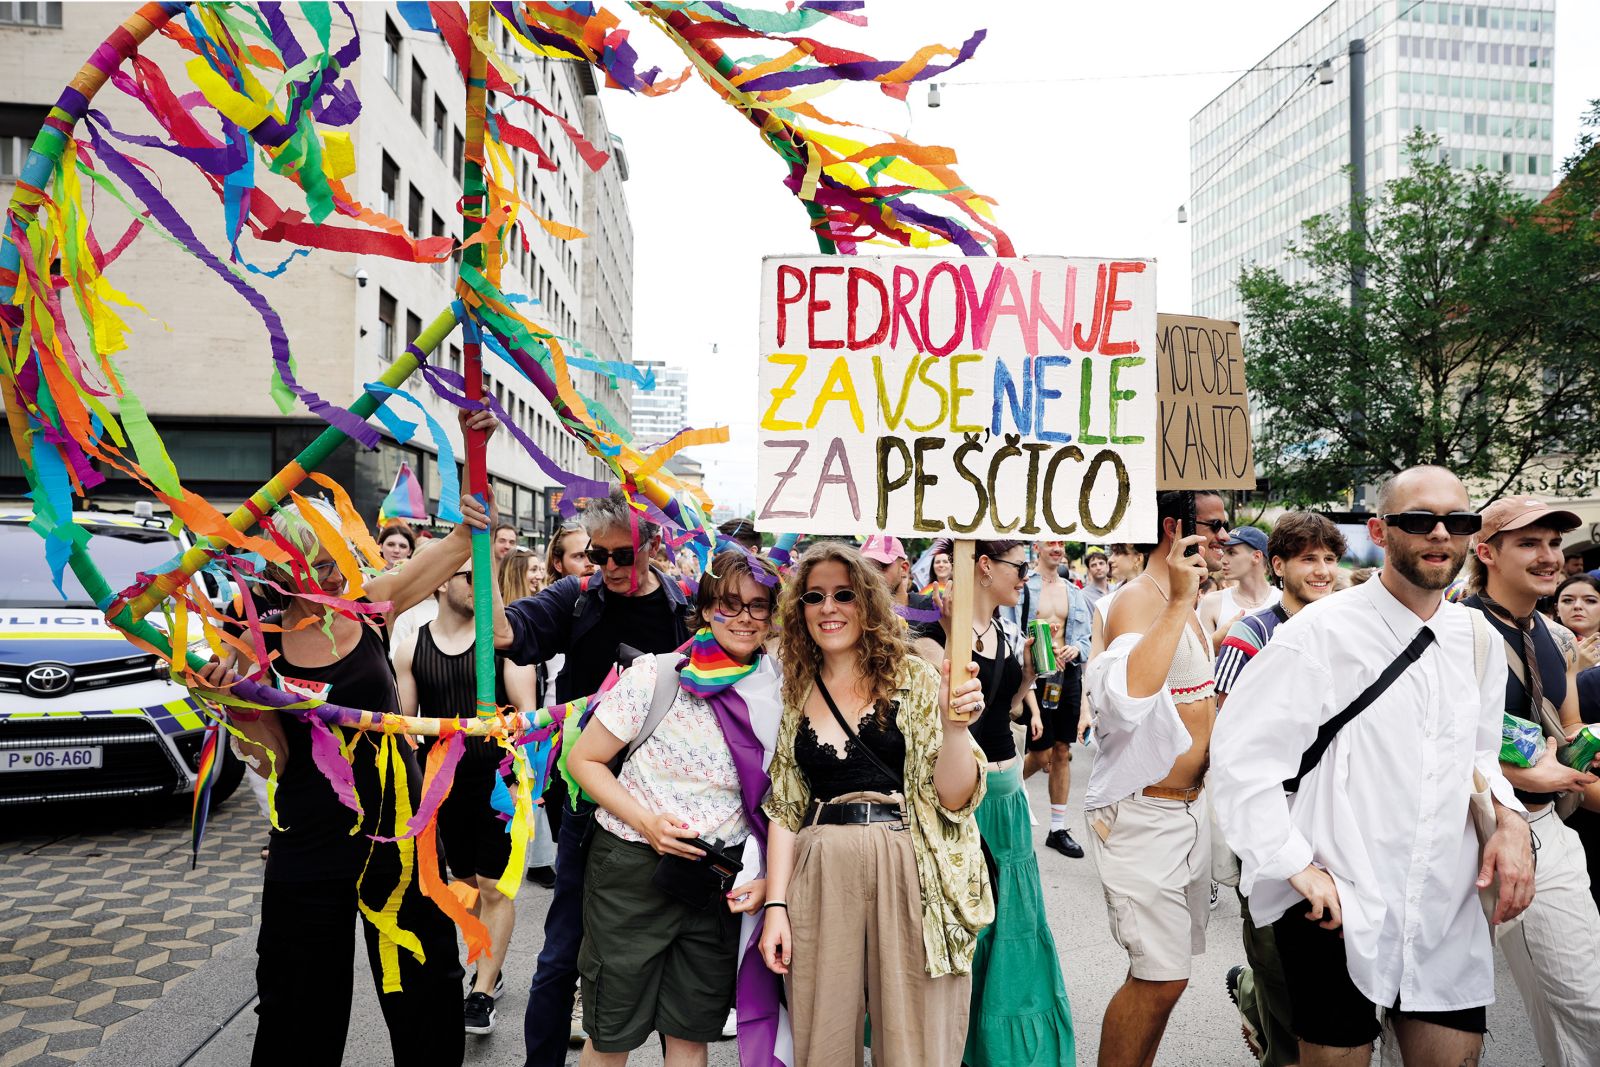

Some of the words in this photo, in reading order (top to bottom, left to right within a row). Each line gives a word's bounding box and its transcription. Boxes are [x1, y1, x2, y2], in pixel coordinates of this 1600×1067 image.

[777, 261, 1146, 357] PEDROVANJE
[760, 354, 865, 433] ZA
[992, 355, 1072, 443] NE
[1078, 357, 1146, 445] LE
[1156, 325, 1243, 397] MOFOBE
[1160, 400, 1249, 480] KANTO
[758, 437, 861, 521] ZA
[876, 433, 1131, 536] PEŠČICO
[34, 750, 92, 767] 06-A60
